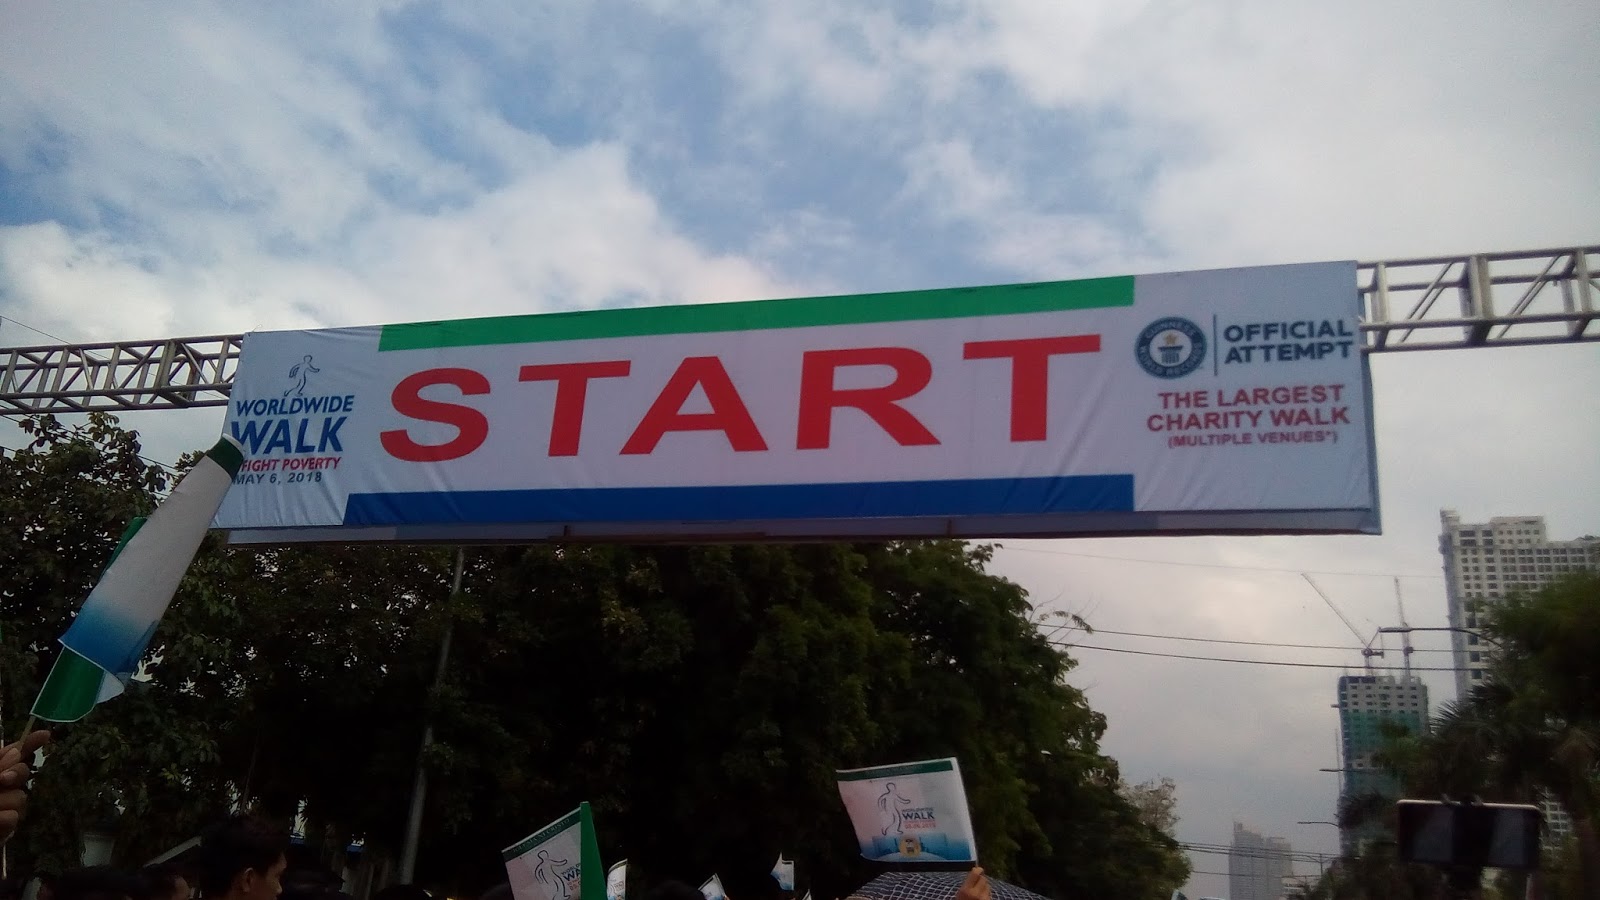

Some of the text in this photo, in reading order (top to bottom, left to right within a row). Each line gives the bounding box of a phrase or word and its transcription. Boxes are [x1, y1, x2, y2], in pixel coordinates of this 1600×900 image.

[1224, 319, 1354, 342] OFFICIAL
[1224, 340, 1354, 364] ATTEMPT
[236, 395, 355, 417] WORLDWIDE
[379, 334, 1102, 463] START
[1158, 384, 1345, 409] THE LARGEST
[1147, 406, 1350, 432] CHARITY WALK
[231, 416, 348, 455] WALK
[1168, 433, 1252, 449] (MULTIPLE
[241, 457, 342, 472] FIGHT POVERTY
[232, 471, 322, 485] MAY 6, 2018
[902, 811, 935, 820] WALK
